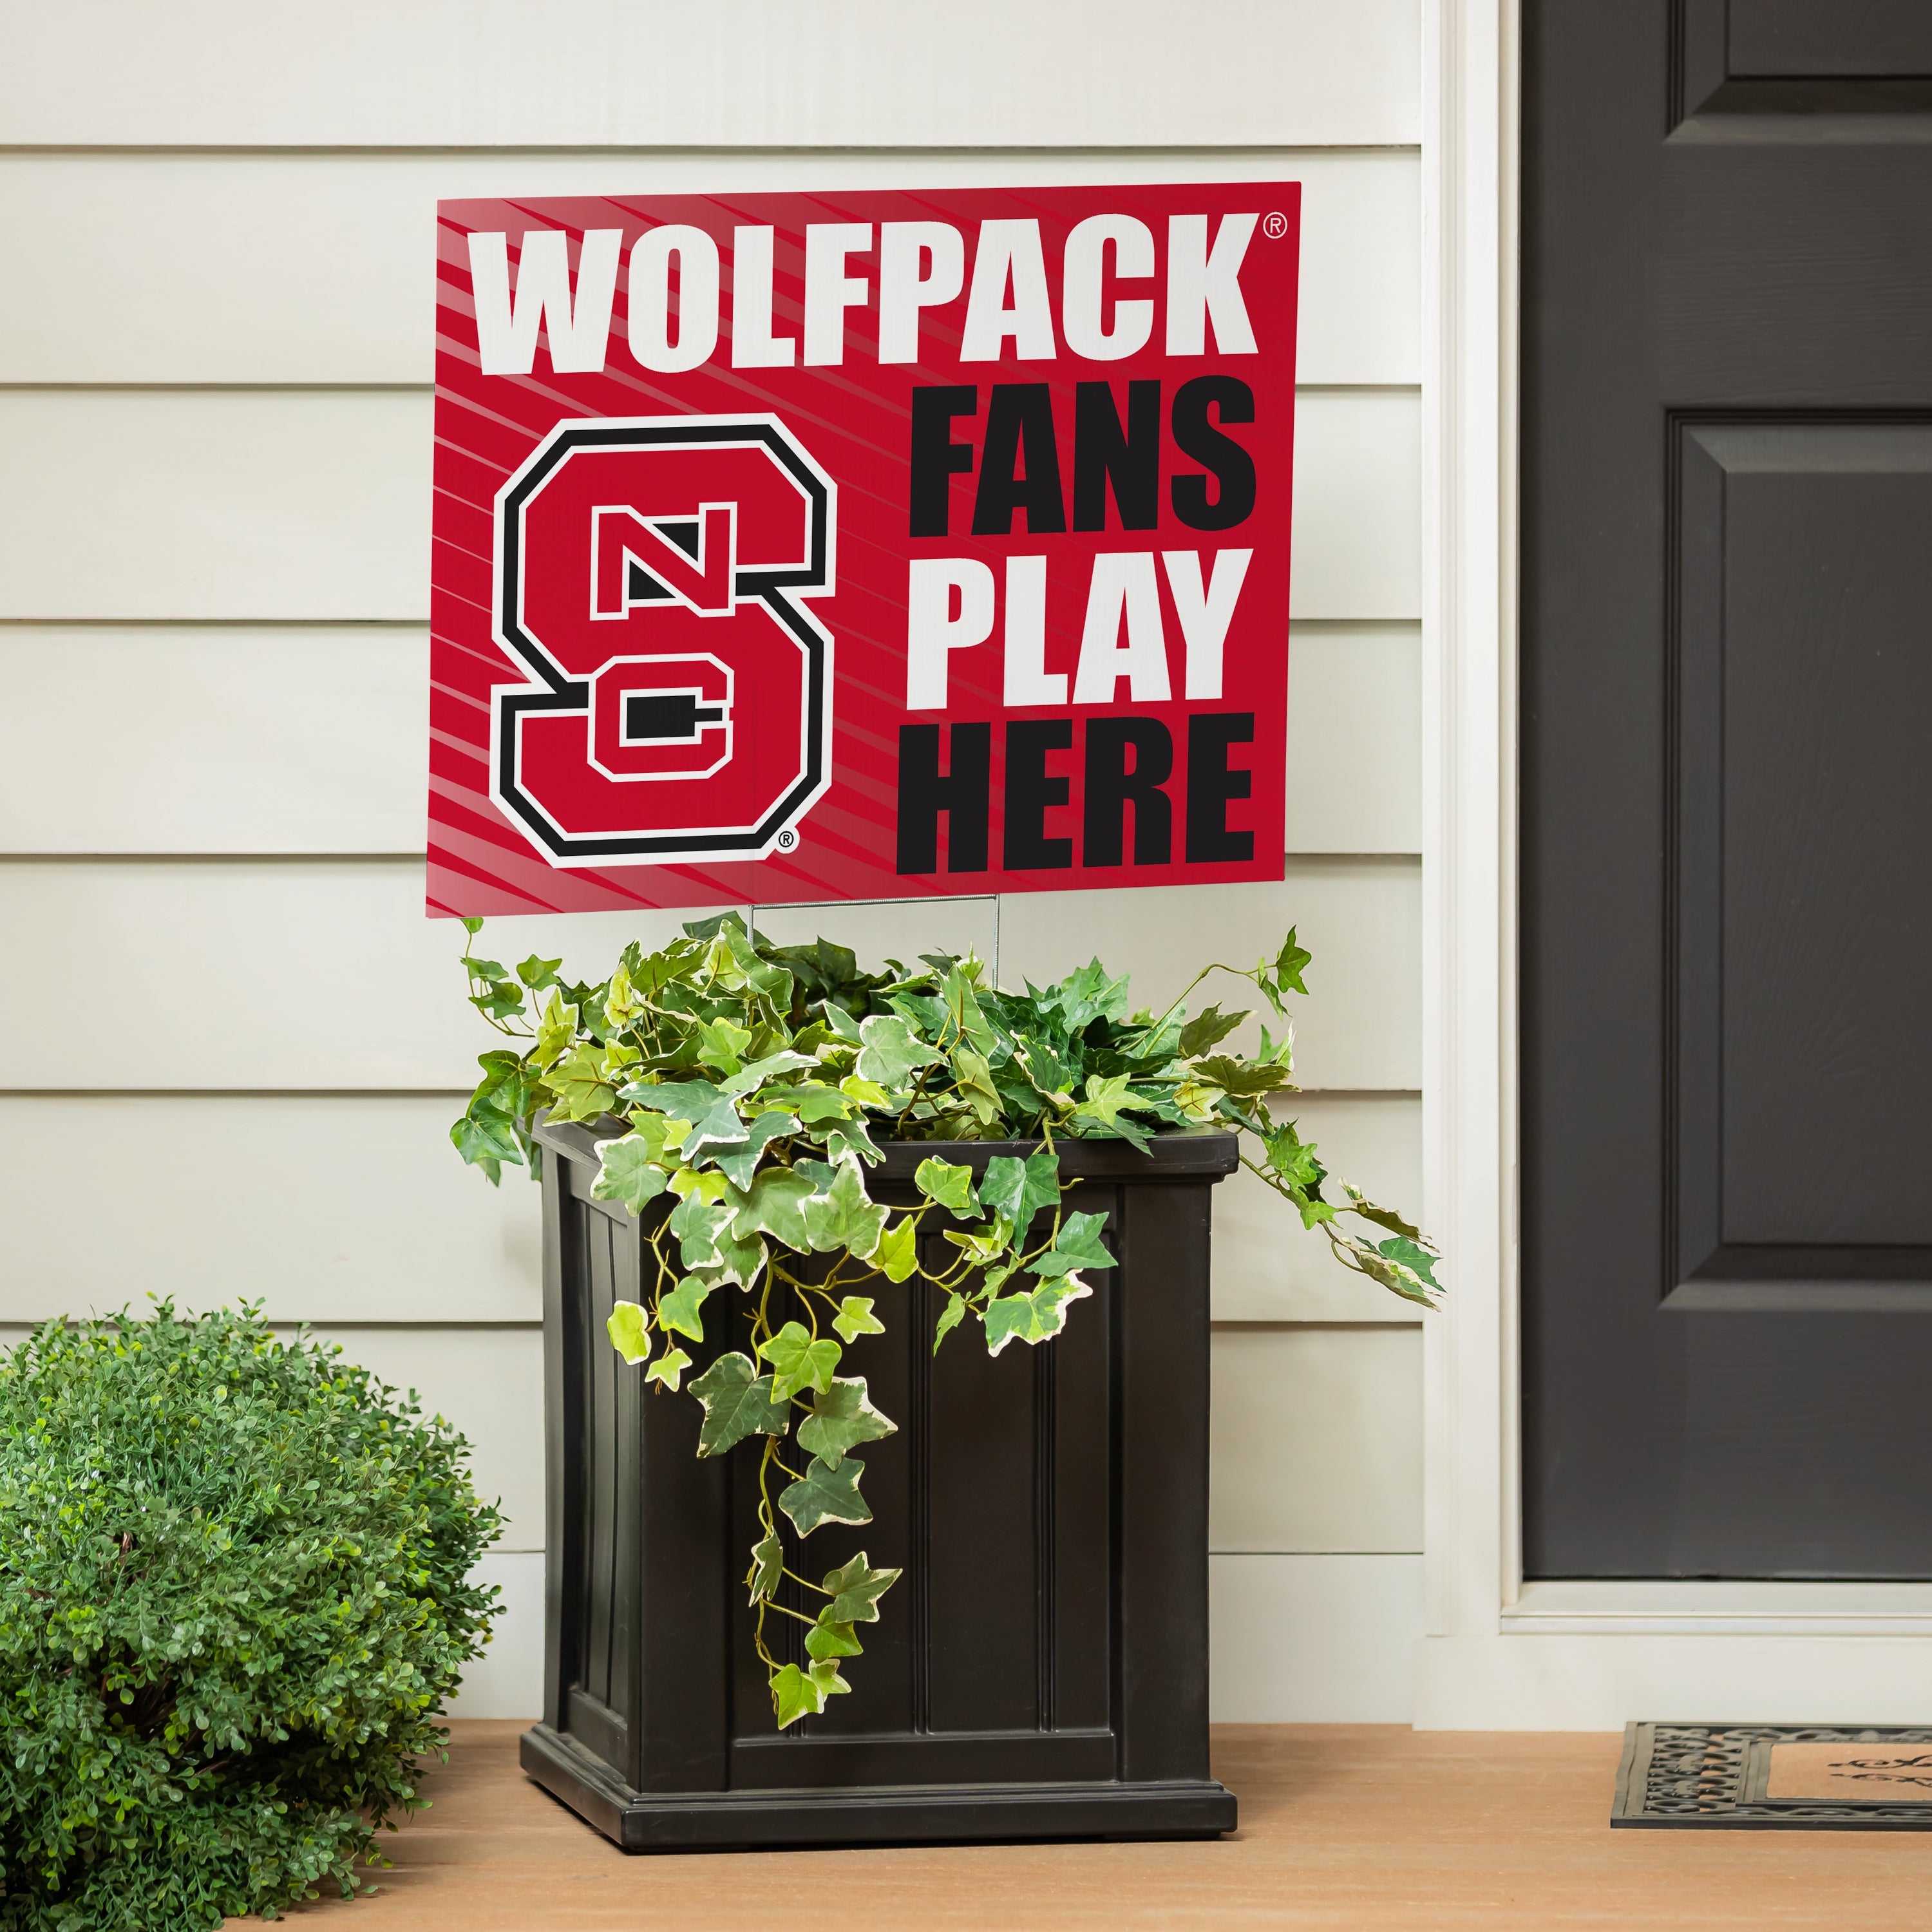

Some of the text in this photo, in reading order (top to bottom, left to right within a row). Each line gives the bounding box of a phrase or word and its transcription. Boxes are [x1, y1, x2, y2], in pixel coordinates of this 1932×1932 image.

[910, 375, 1256, 537] FANS
[907, 548, 1254, 710] PLAY
[896, 712, 1255, 875] HERE
